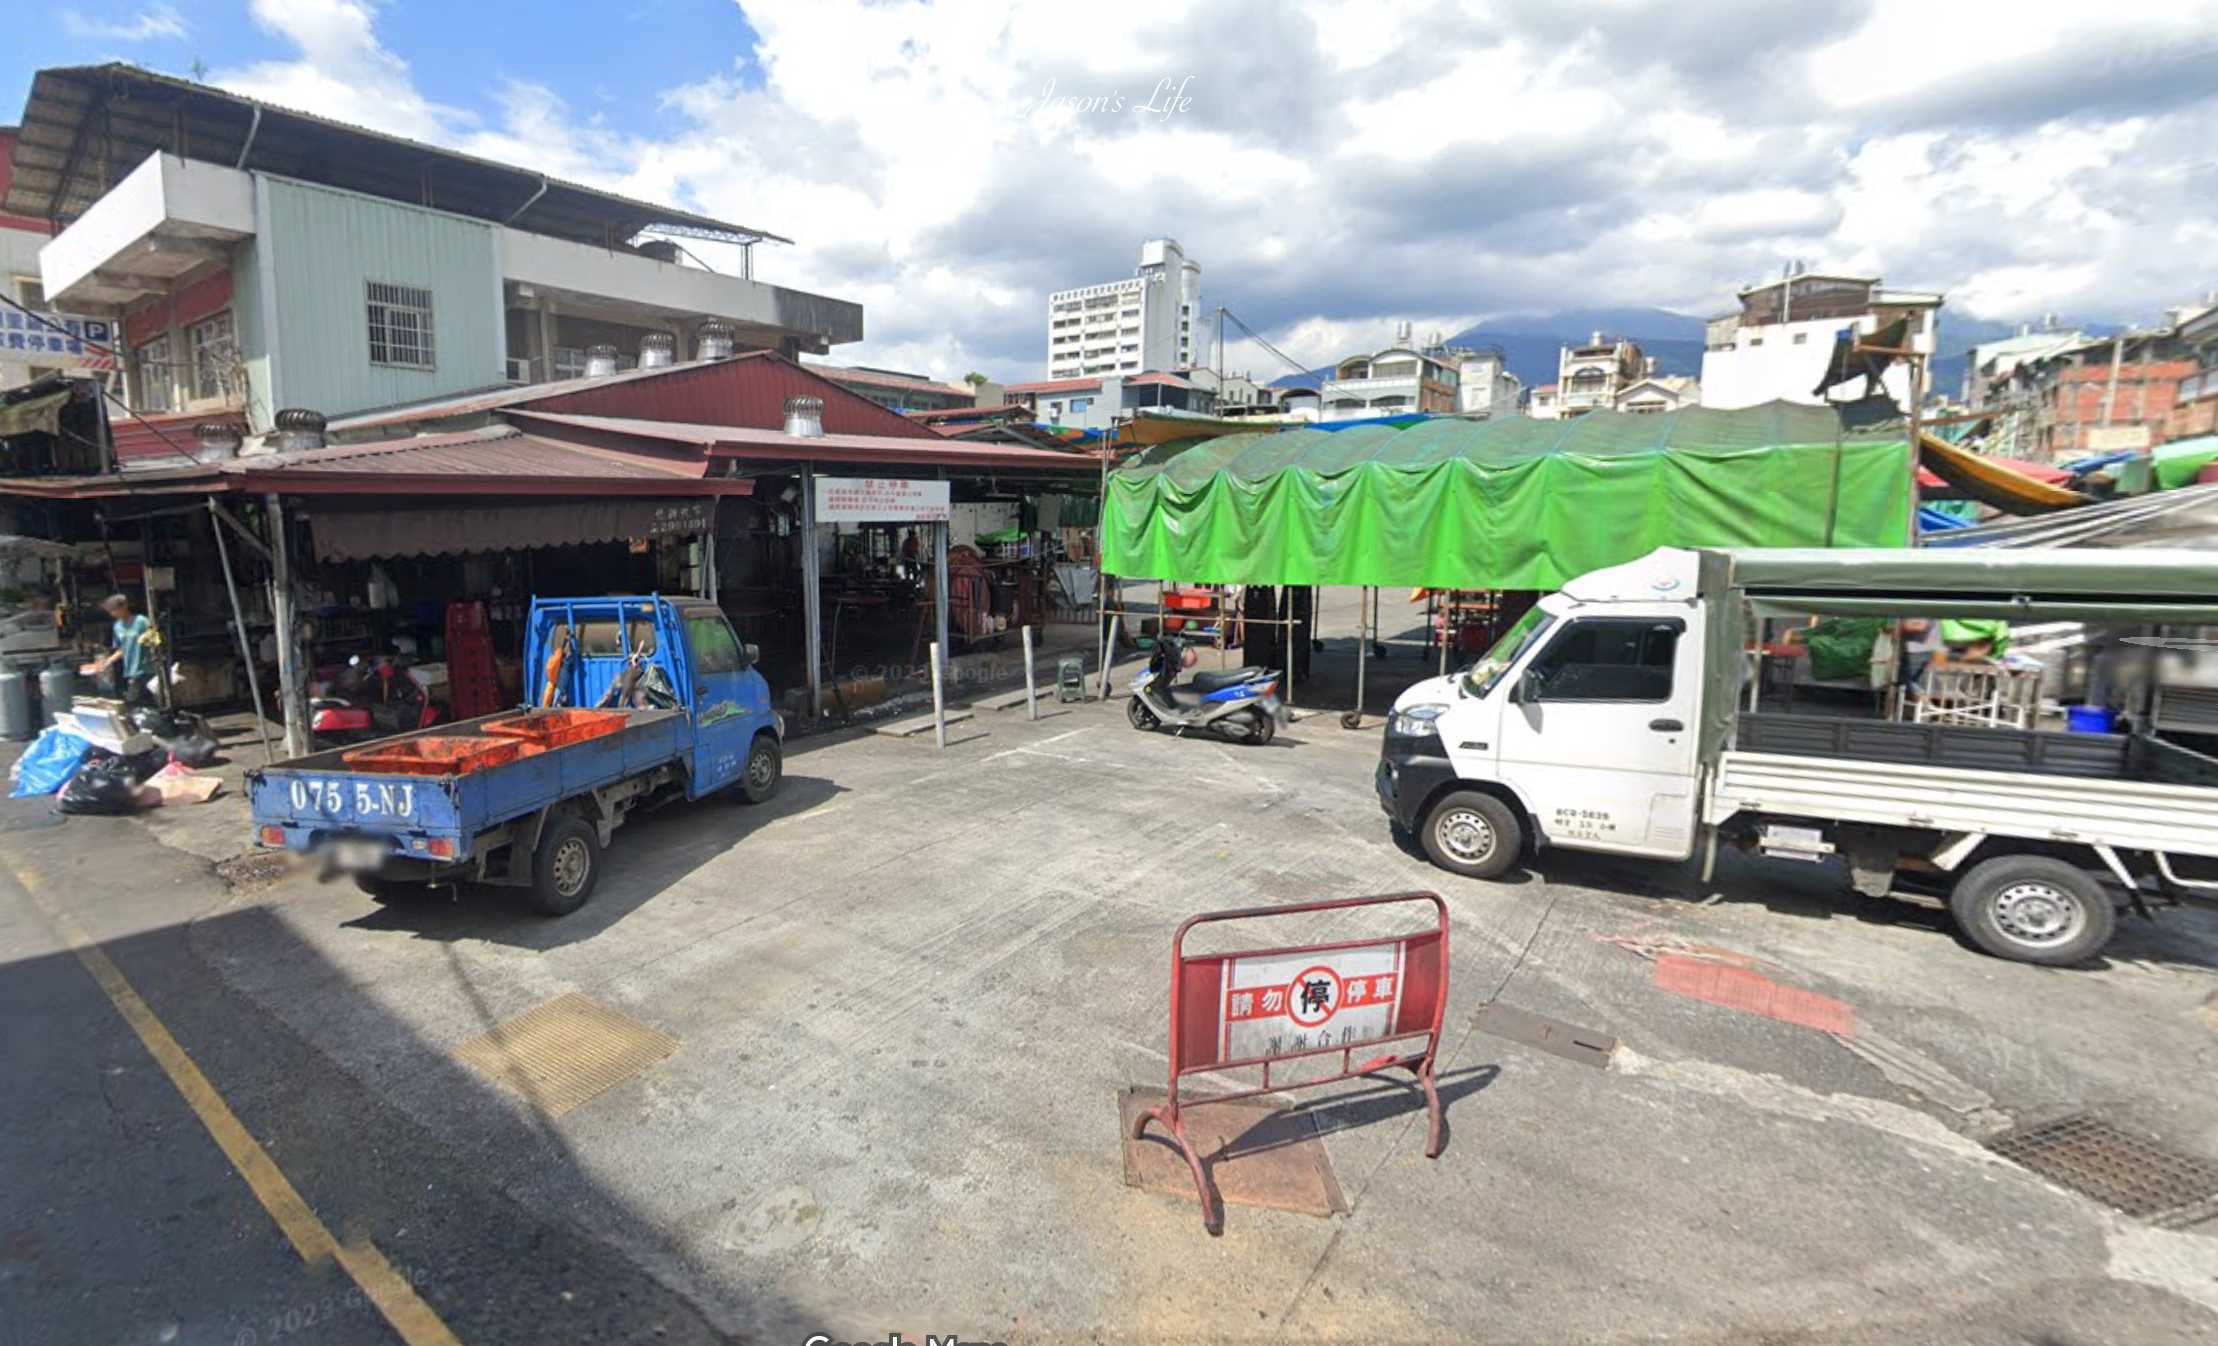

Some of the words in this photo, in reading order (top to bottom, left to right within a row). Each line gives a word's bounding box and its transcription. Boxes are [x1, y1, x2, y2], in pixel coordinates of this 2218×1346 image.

[1231, 989, 1282, 1016] 請勿
[1300, 979, 1330, 1014] 停
[1347, 977, 1393, 1002] 停車
